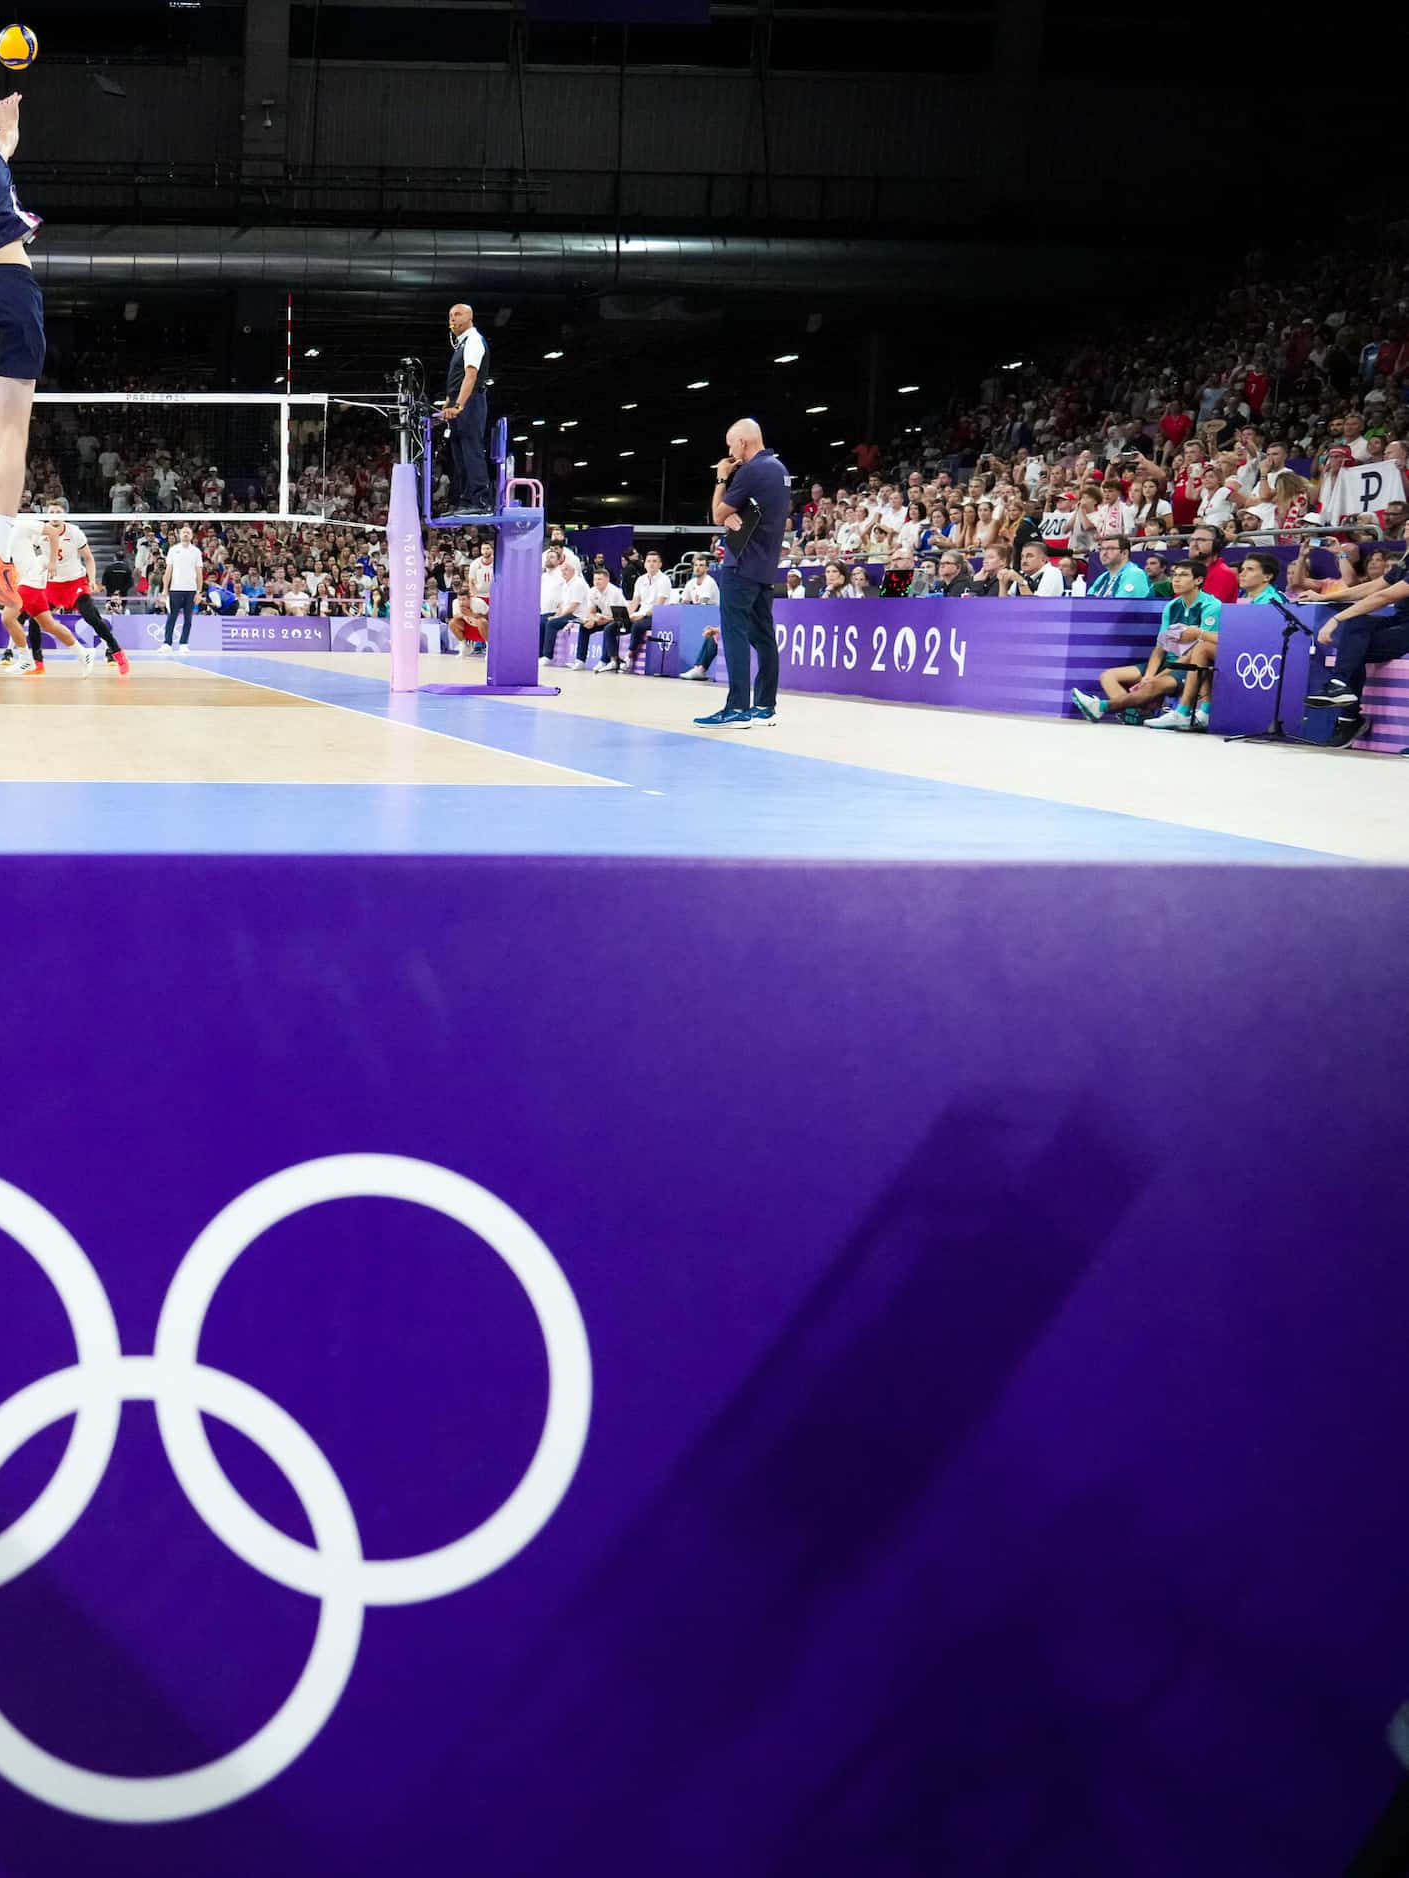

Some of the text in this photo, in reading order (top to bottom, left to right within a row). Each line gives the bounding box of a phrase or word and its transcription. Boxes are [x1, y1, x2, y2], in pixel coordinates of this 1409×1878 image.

[405, 534, 417, 630] PARIS 2024
[231, 628, 322, 639] PARIS 2024
[870, 624, 967, 677] 2024
